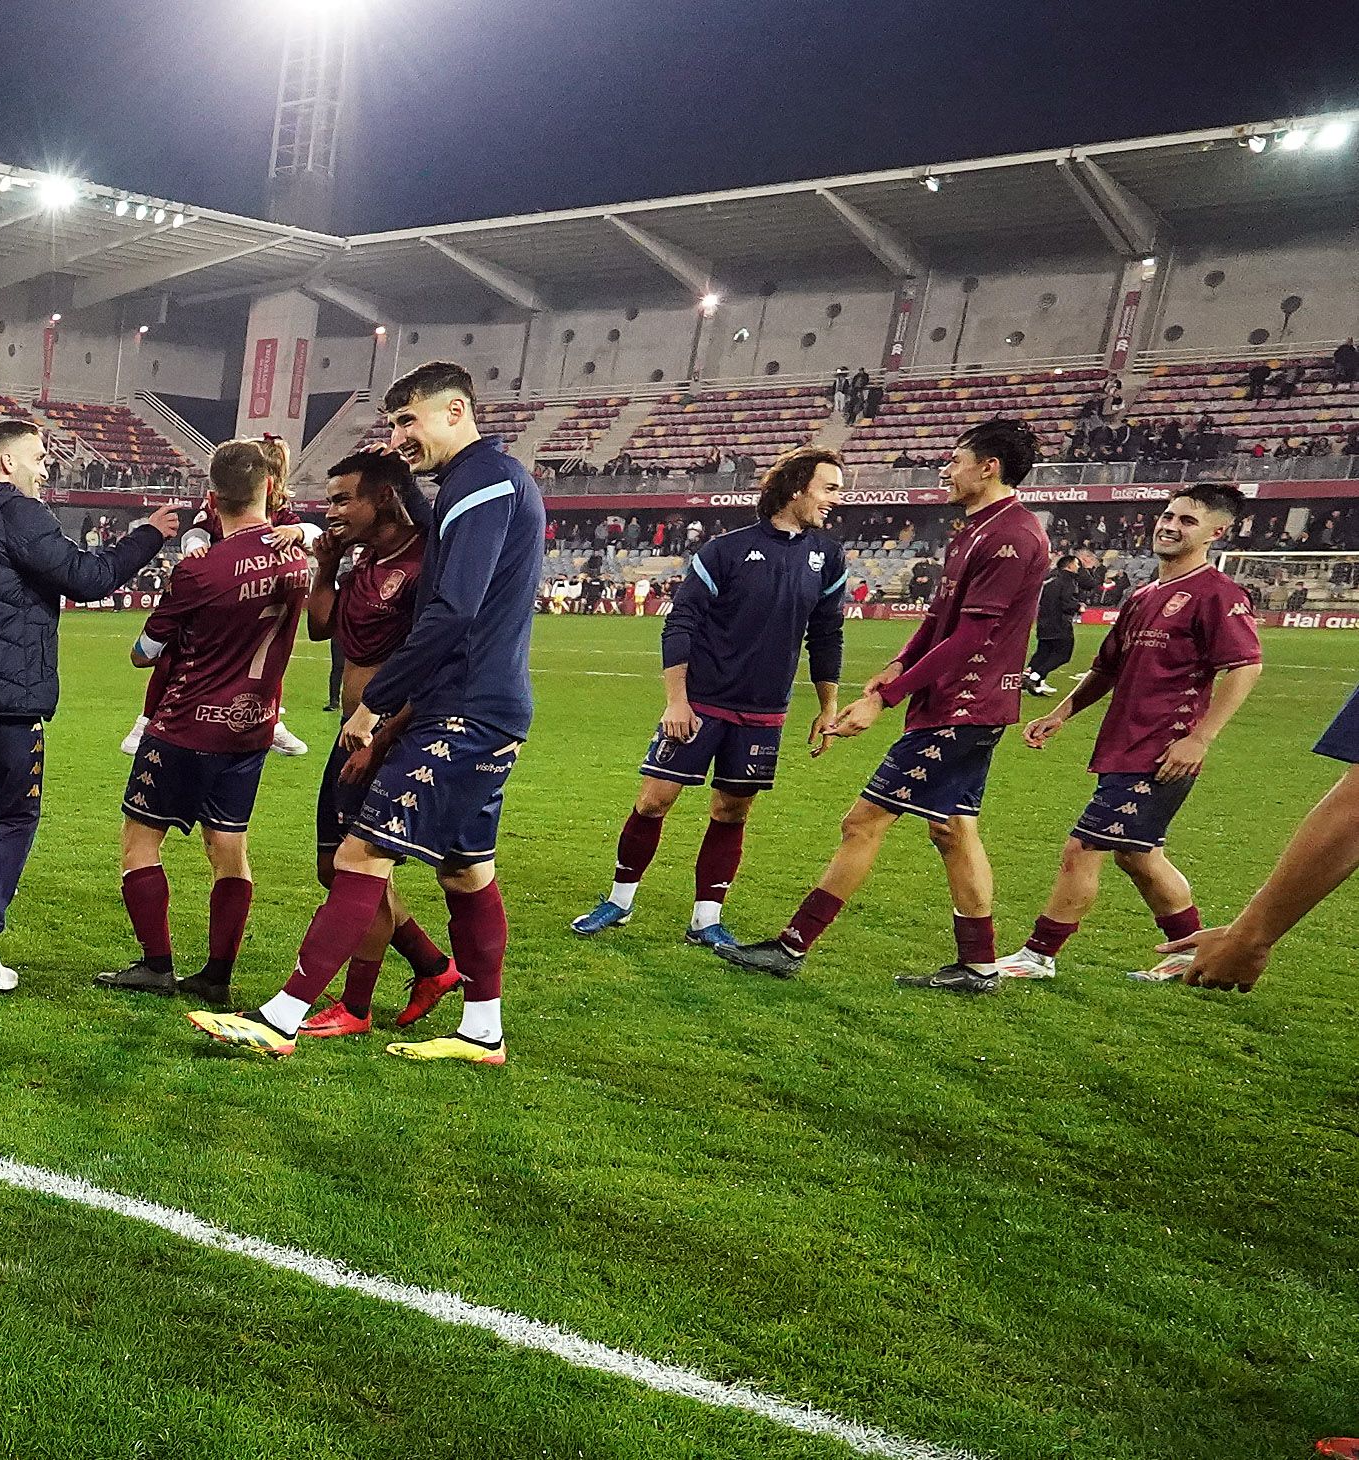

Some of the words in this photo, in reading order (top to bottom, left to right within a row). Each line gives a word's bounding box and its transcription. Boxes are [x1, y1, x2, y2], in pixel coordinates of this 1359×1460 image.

[239, 575, 279, 602] ALEX
[1283, 613, 1321, 628] Hai
[248, 603, 289, 680] 7
[195, 698, 277, 724] PESCAM
